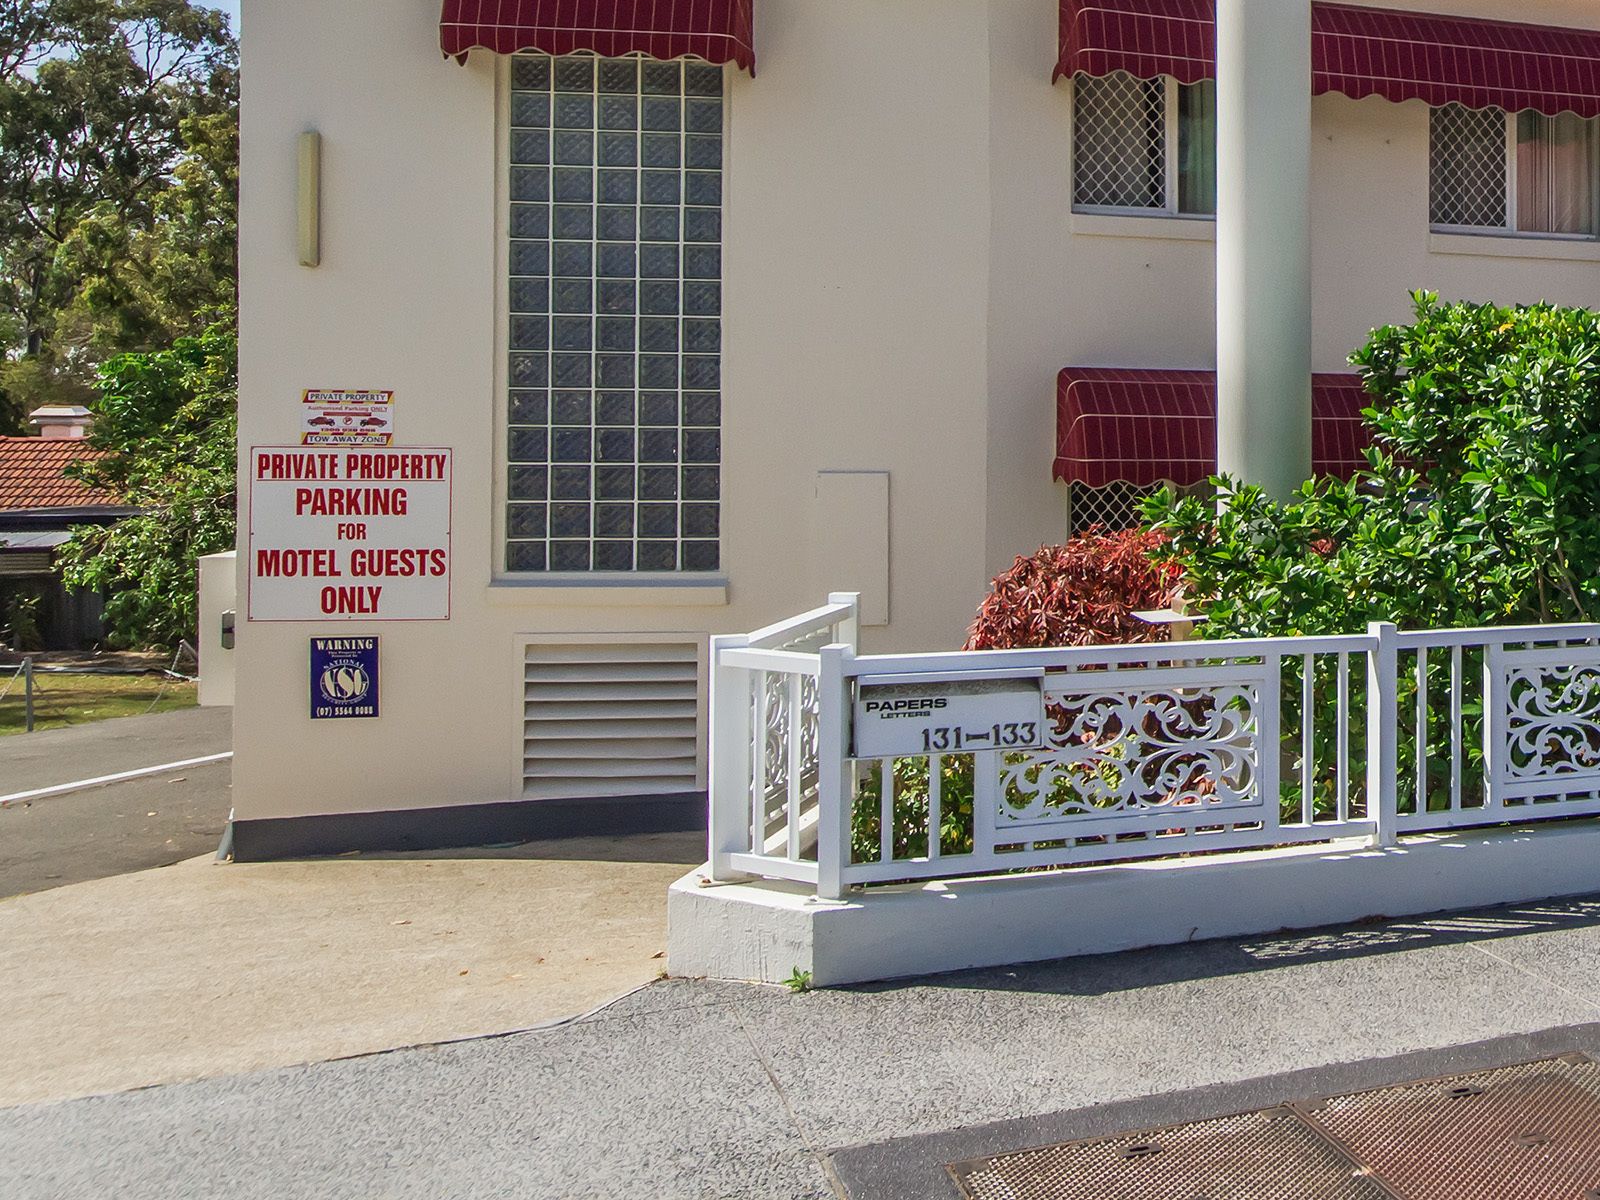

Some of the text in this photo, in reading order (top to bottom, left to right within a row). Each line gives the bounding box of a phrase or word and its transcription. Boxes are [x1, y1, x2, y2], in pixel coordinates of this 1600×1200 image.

[345, 393, 386, 401] PROPERTY
[308, 435, 331, 443] TOW
[332, 435, 358, 443] AWAY
[257, 453, 447, 480] PRIVATE PROPERTY
[296, 488, 407, 516] PARKING
[337, 522, 367, 540] FOR
[257, 548, 447, 577] MOTEL GUESTS
[320, 586, 382, 614] ONLY
[316, 639, 373, 650] WARNING
[316, 706, 333, 717] (07)
[866, 698, 948, 713] PAPERS
[880, 710, 931, 720] LETTERS
[921, 721, 1037, 751] 131-133
